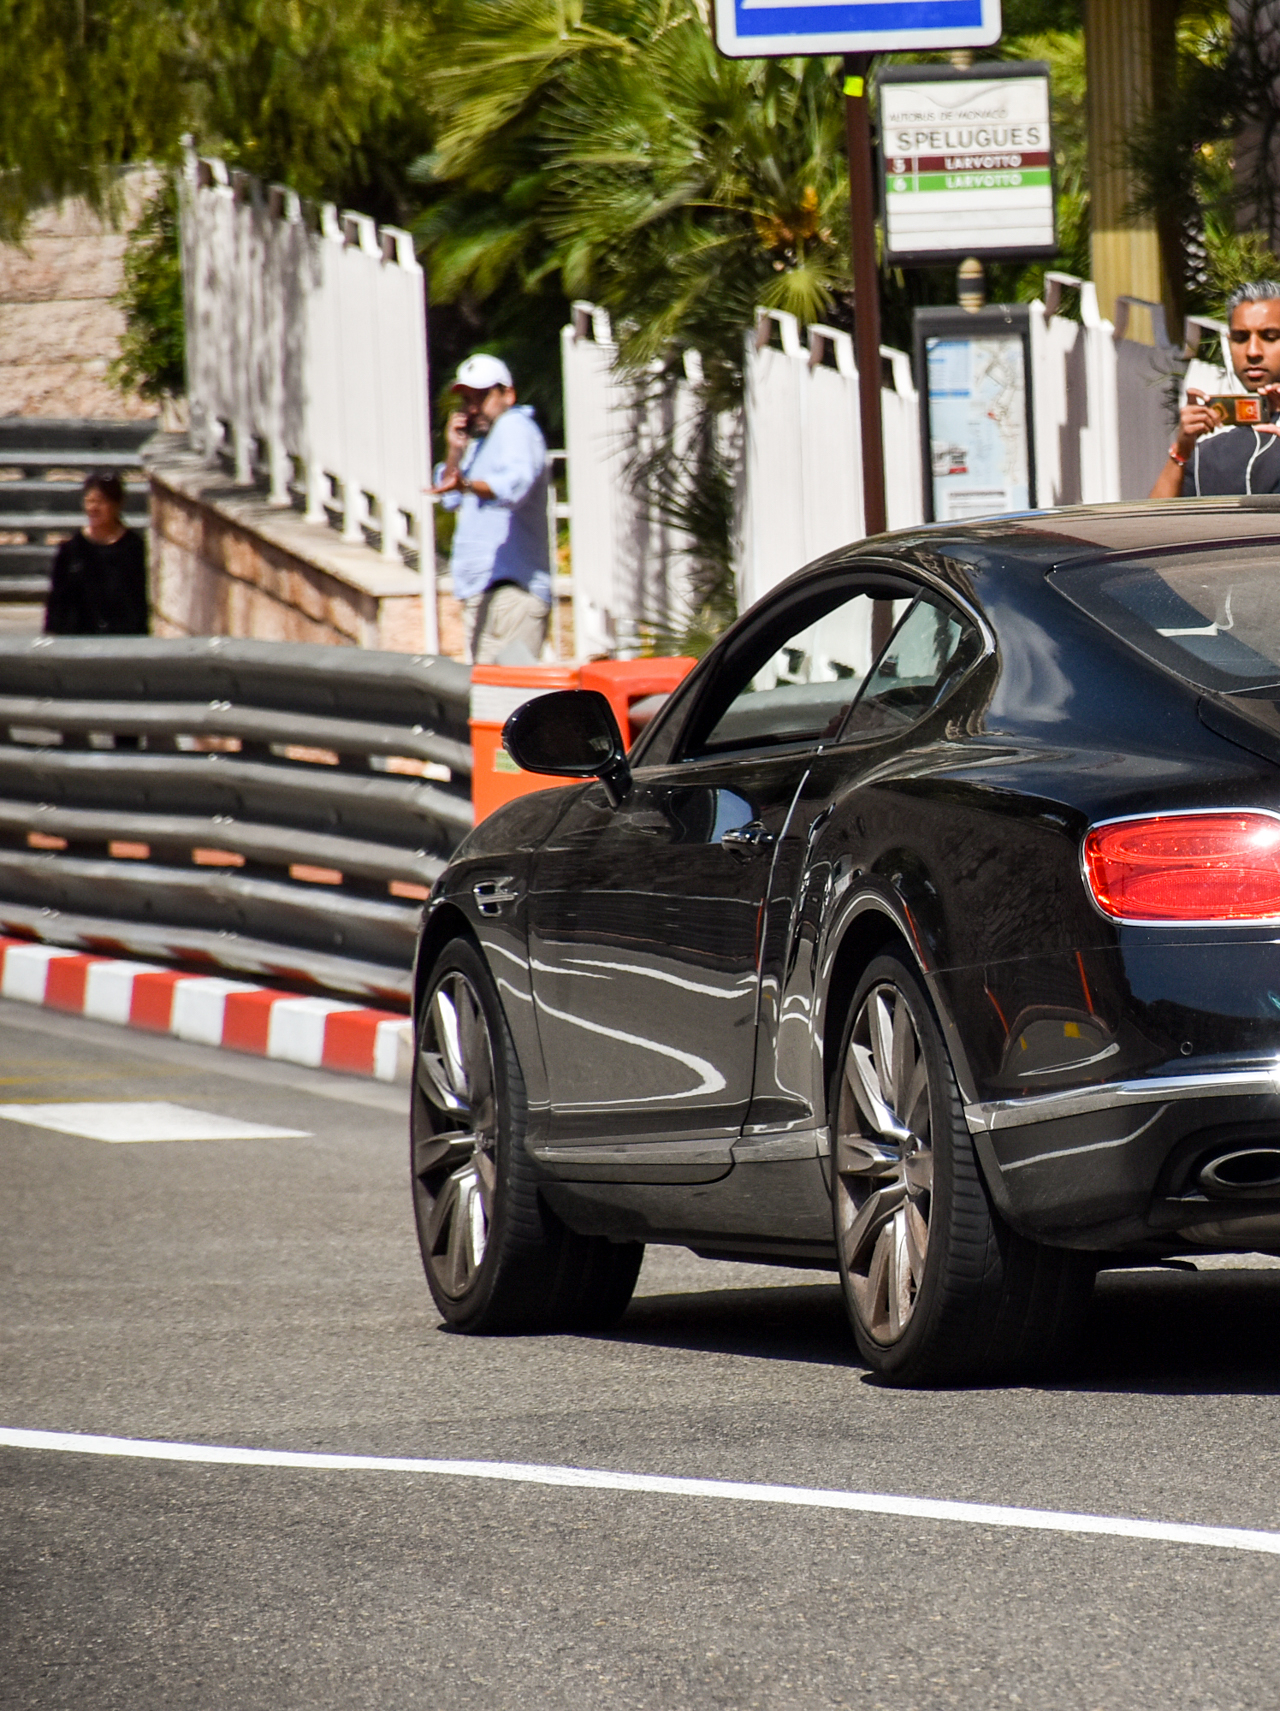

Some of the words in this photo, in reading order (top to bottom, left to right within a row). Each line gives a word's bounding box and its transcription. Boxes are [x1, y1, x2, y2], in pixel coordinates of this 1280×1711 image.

[897, 126, 1041, 151] SPELUGUES
[892, 157, 906, 174] 5
[944, 153, 1023, 170] LARVOTTO
[893, 176, 907, 192] 6
[945, 173, 1023, 188] LARVOTTO
